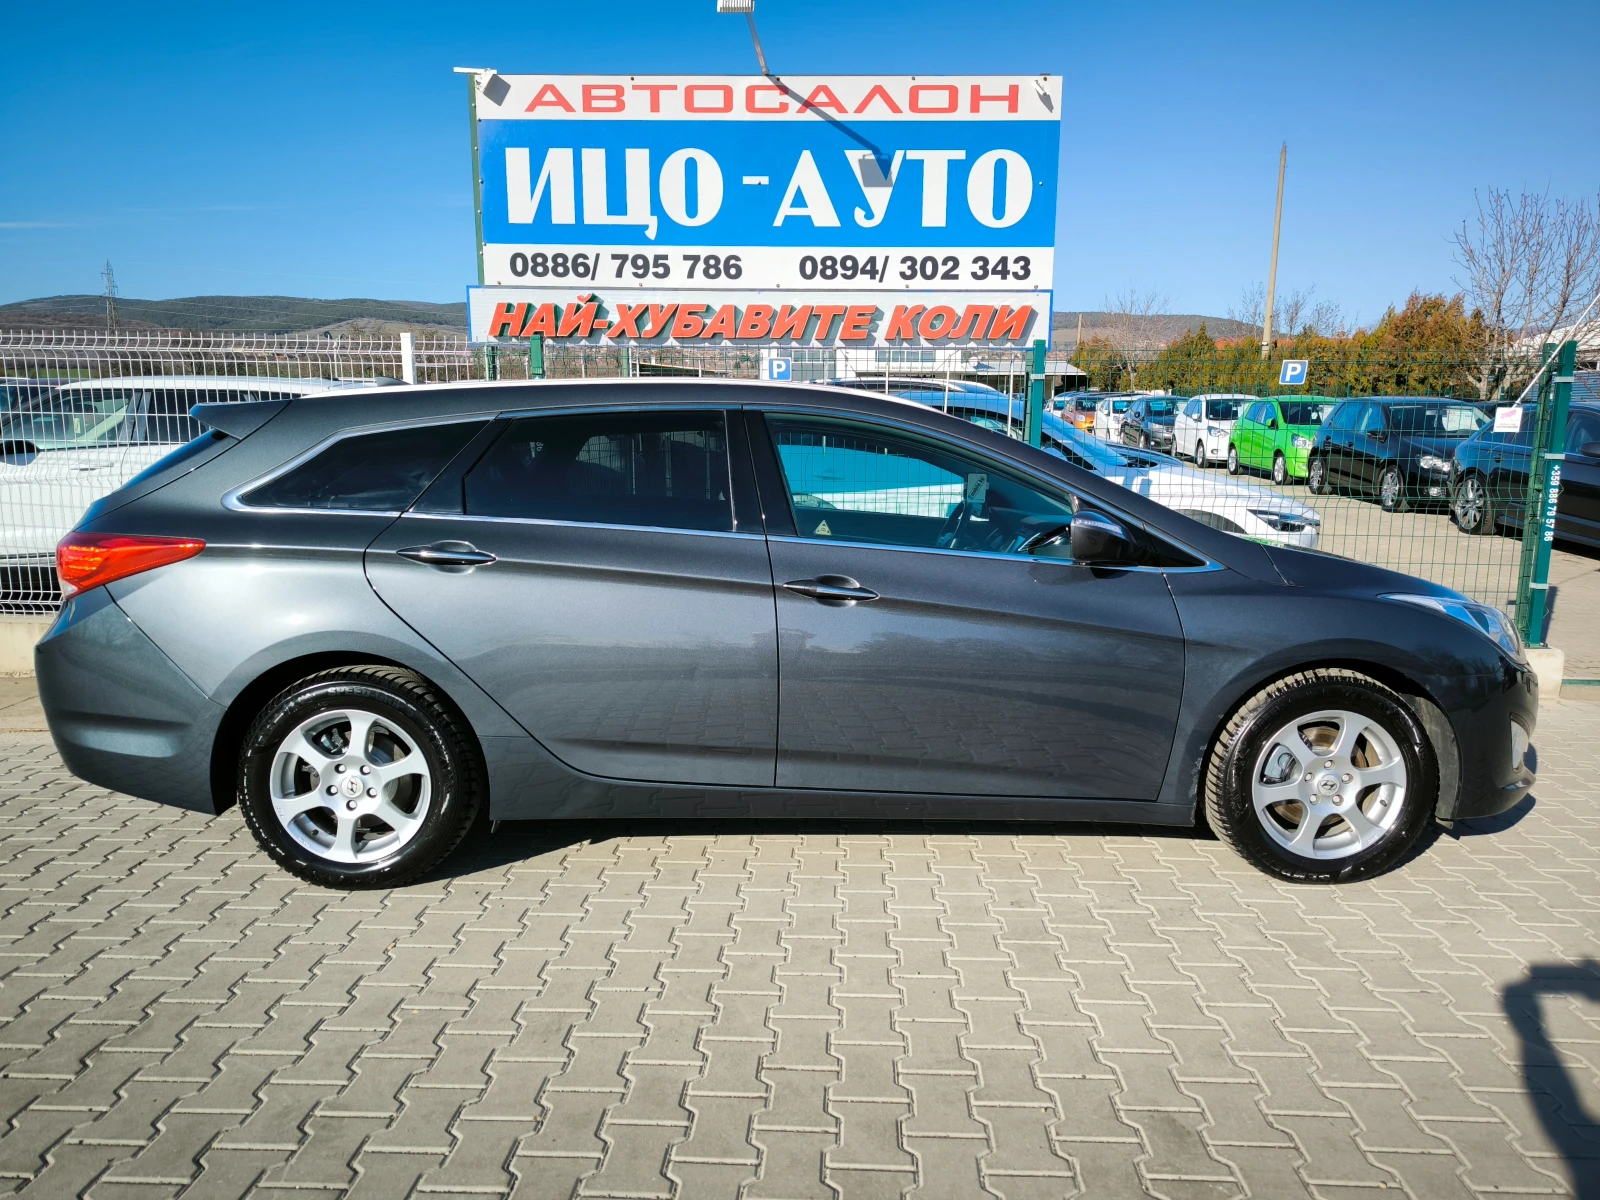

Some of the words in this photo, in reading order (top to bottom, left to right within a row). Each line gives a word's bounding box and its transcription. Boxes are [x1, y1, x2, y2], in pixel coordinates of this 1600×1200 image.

[526, 83, 1019, 114] АВТОСАЛОН
[505, 147, 724, 241] ИЦО
[509, 252, 601, 281] 0886/
[610, 253, 671, 280] 795
[682, 254, 743, 280] 786
[799, 254, 890, 283] 0894/
[899, 255, 960, 281] 302
[970, 255, 1031, 281] 343
[488, 293, 878, 340] НАЙ-ХУБАВИТЕ
[884, 303, 1033, 341] КОЛИ
[772, 360, 786, 379] P
[1285, 363, 1302, 382] P
[1550, 464, 1561, 486] +359
[1548, 488, 1559, 504] 886
[1546, 505, 1557, 517] 79
[1545, 518, 1556, 529] 57
